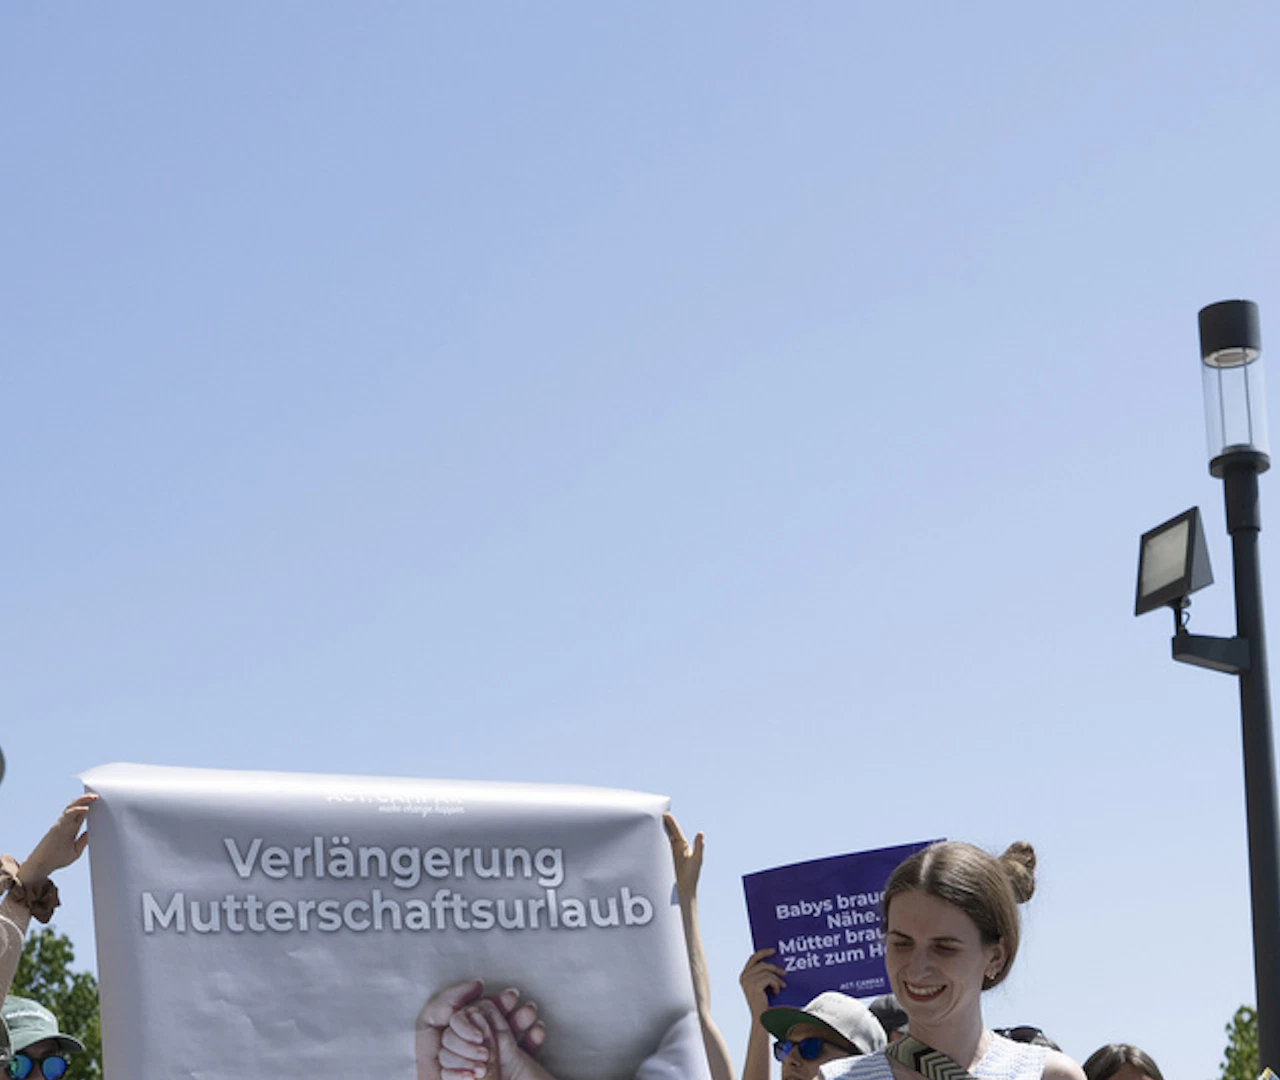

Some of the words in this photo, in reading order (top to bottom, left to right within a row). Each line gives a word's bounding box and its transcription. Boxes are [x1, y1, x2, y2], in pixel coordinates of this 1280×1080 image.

[224, 835, 564, 888] Verlängerung
[142, 886, 654, 933] Mutterschaftsurlaub
[776, 899, 833, 920] Babys
[826, 910, 880, 929] Nähe.
[778, 933, 841, 955] Mütter
[784, 952, 821, 972] Zeit
[824, 948, 865, 966] zum
